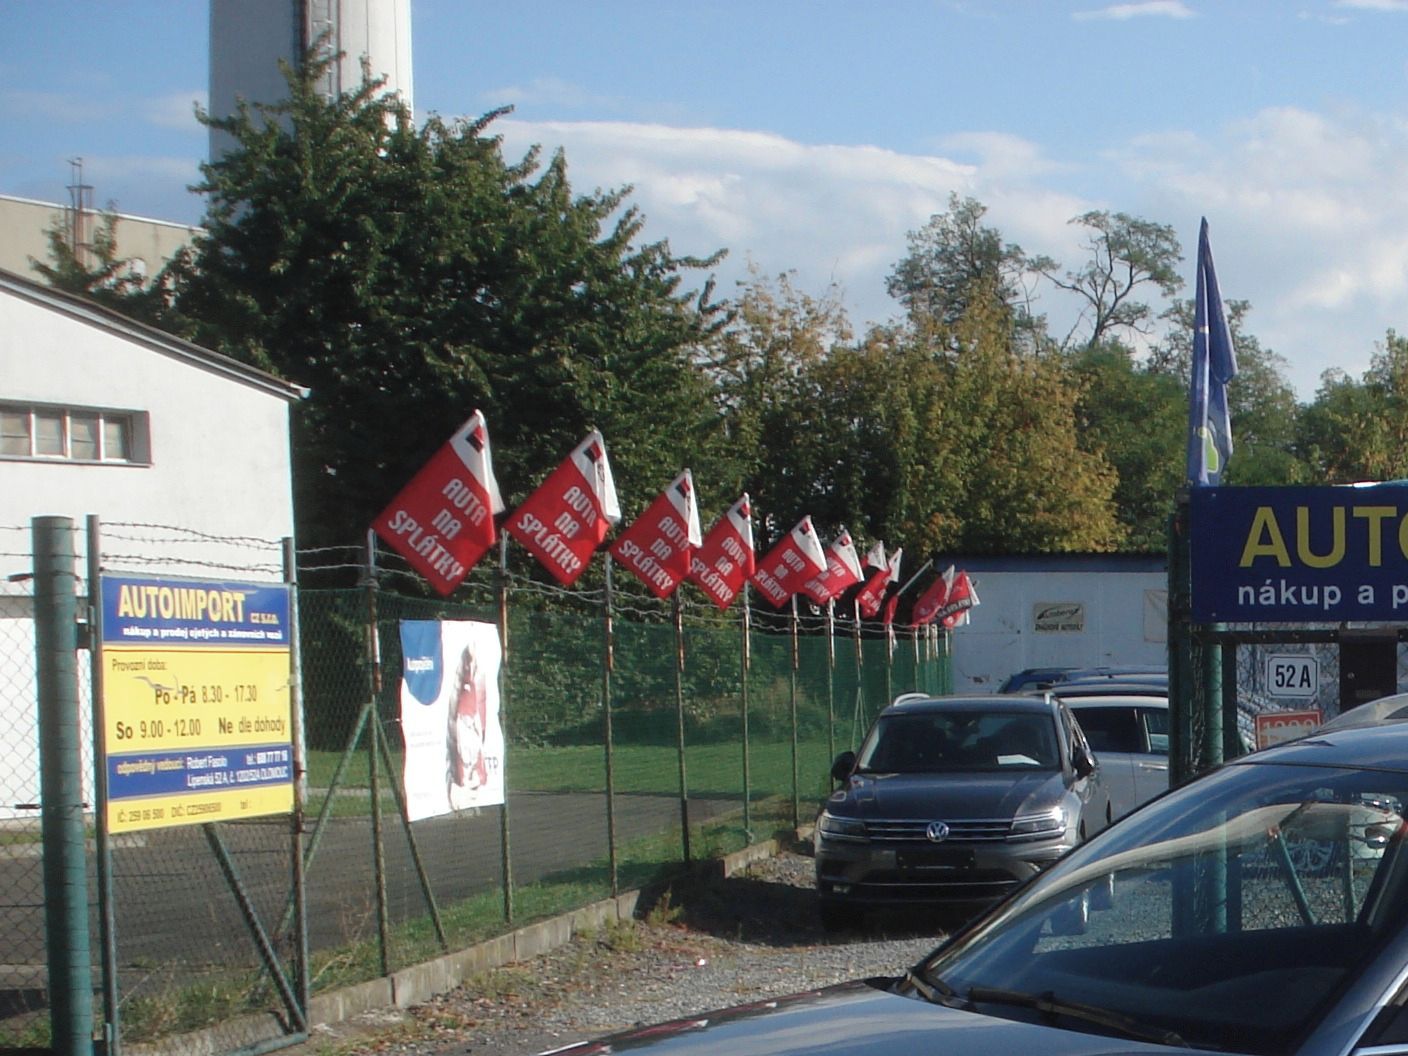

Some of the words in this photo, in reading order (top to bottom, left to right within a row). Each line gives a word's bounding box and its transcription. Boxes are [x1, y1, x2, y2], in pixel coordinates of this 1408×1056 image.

[441, 478, 488, 526] AUTA
[562, 485, 597, 528] AUTA
[431, 508, 462, 540] NA
[554, 511, 580, 538] NA
[657, 516, 690, 551] AUTA
[388, 510, 464, 581] SPLÁTKY
[516, 512, 582, 574] SPLÁTKY
[649, 538, 673, 562] NA
[618, 539, 674, 591] SPLÁTKY
[118, 584, 246, 623] AUTOIMPORT
[1238, 577, 1342, 610] nákup
[1357, 584, 1376, 604] a
[123, 627, 151, 639] nákup
[160, 628, 188, 640] prodej
[189, 628, 220, 640] ojetých
[112, 658, 146, 671] Provozní
[147, 660, 167, 671] doba:
[155, 685, 171, 705] Po
[182, 684, 197, 705] Pá
[202, 685, 223, 703] 8.30
[234, 684, 257, 702] 17.30
[116, 721, 133, 740] So
[140, 719, 164, 738] 9.00
[174, 718, 201, 738] 12.00
[218, 716, 233, 735] Ne
[238, 716, 252, 734] dle
[254, 716, 286, 736] dohody
